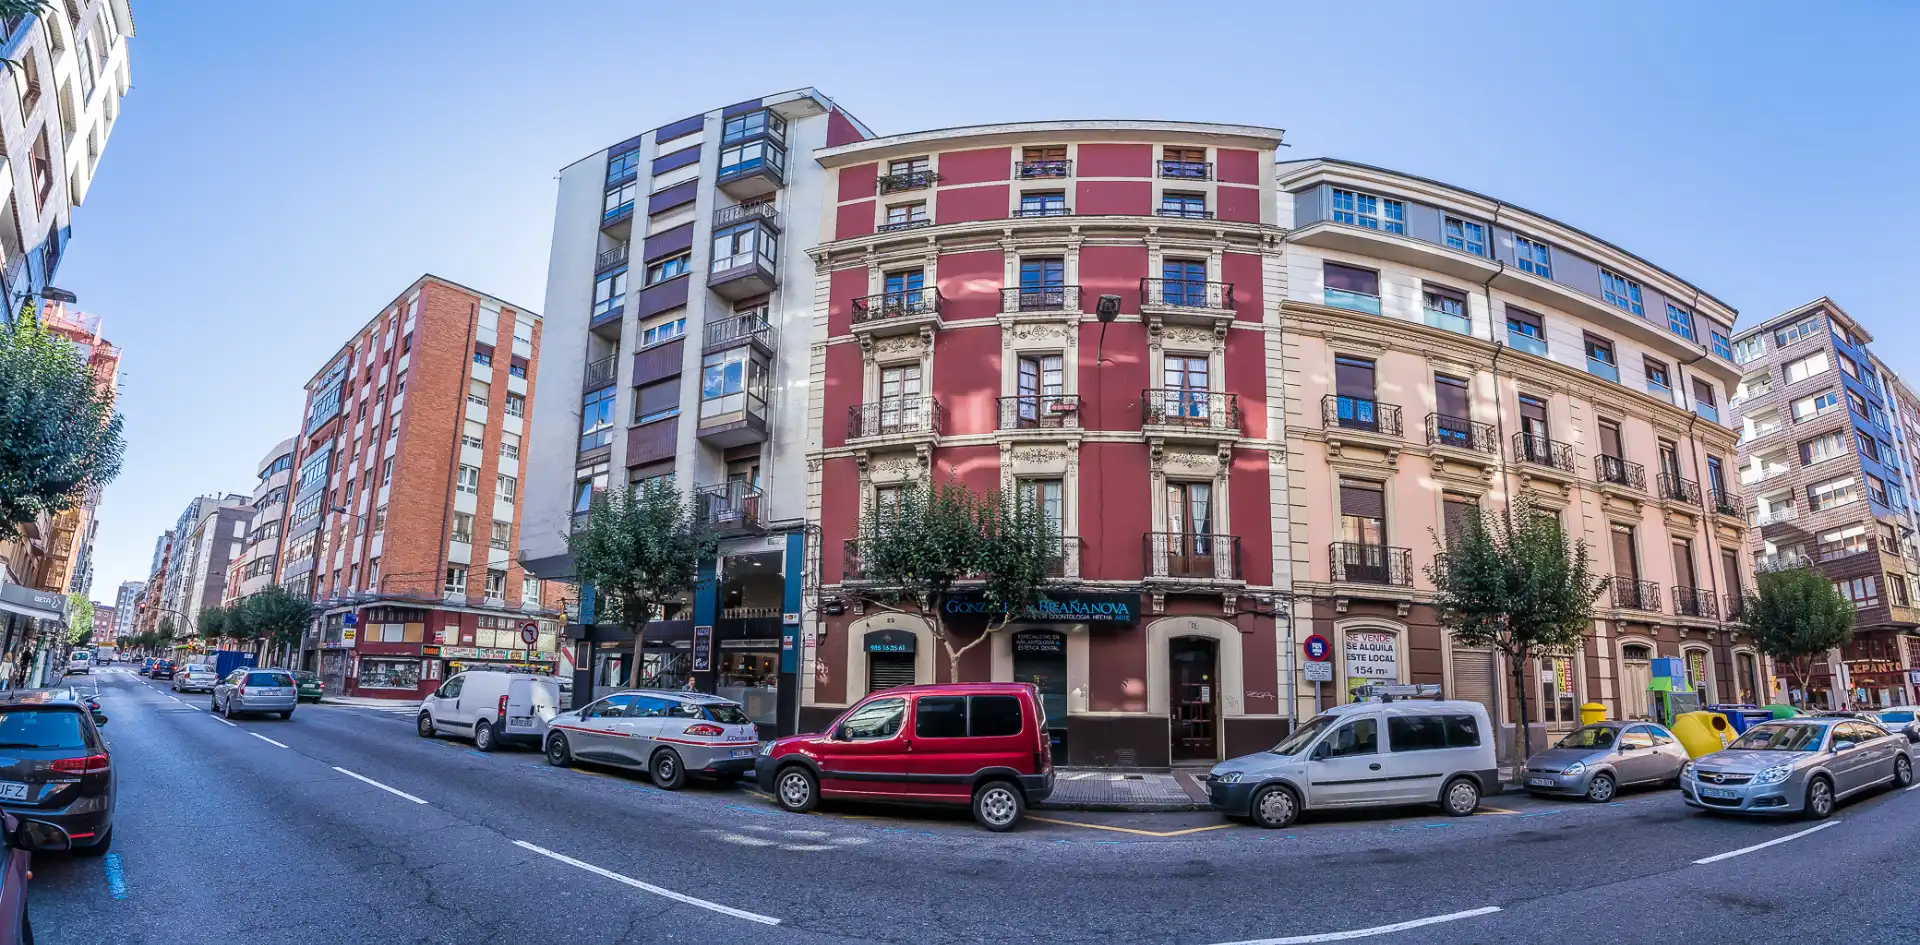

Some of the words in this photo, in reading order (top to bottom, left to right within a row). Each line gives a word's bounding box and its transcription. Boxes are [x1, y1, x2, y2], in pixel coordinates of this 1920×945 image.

[33, 595, 51, 604] BETA
[1039, 599, 1130, 614] BRAÑANOVA
[1347, 633, 1359, 641] SE
[1362, 634, 1391, 642] VENDE
[1346, 642, 1358, 650] SE
[1360, 643, 1393, 652] ALQUILA
[1346, 653, 1367, 661] ESTE
[1369, 654, 1395, 662] LOCAL
[1354, 665, 1373, 674] 154
[1850, 662, 1901, 674] EPANTO
